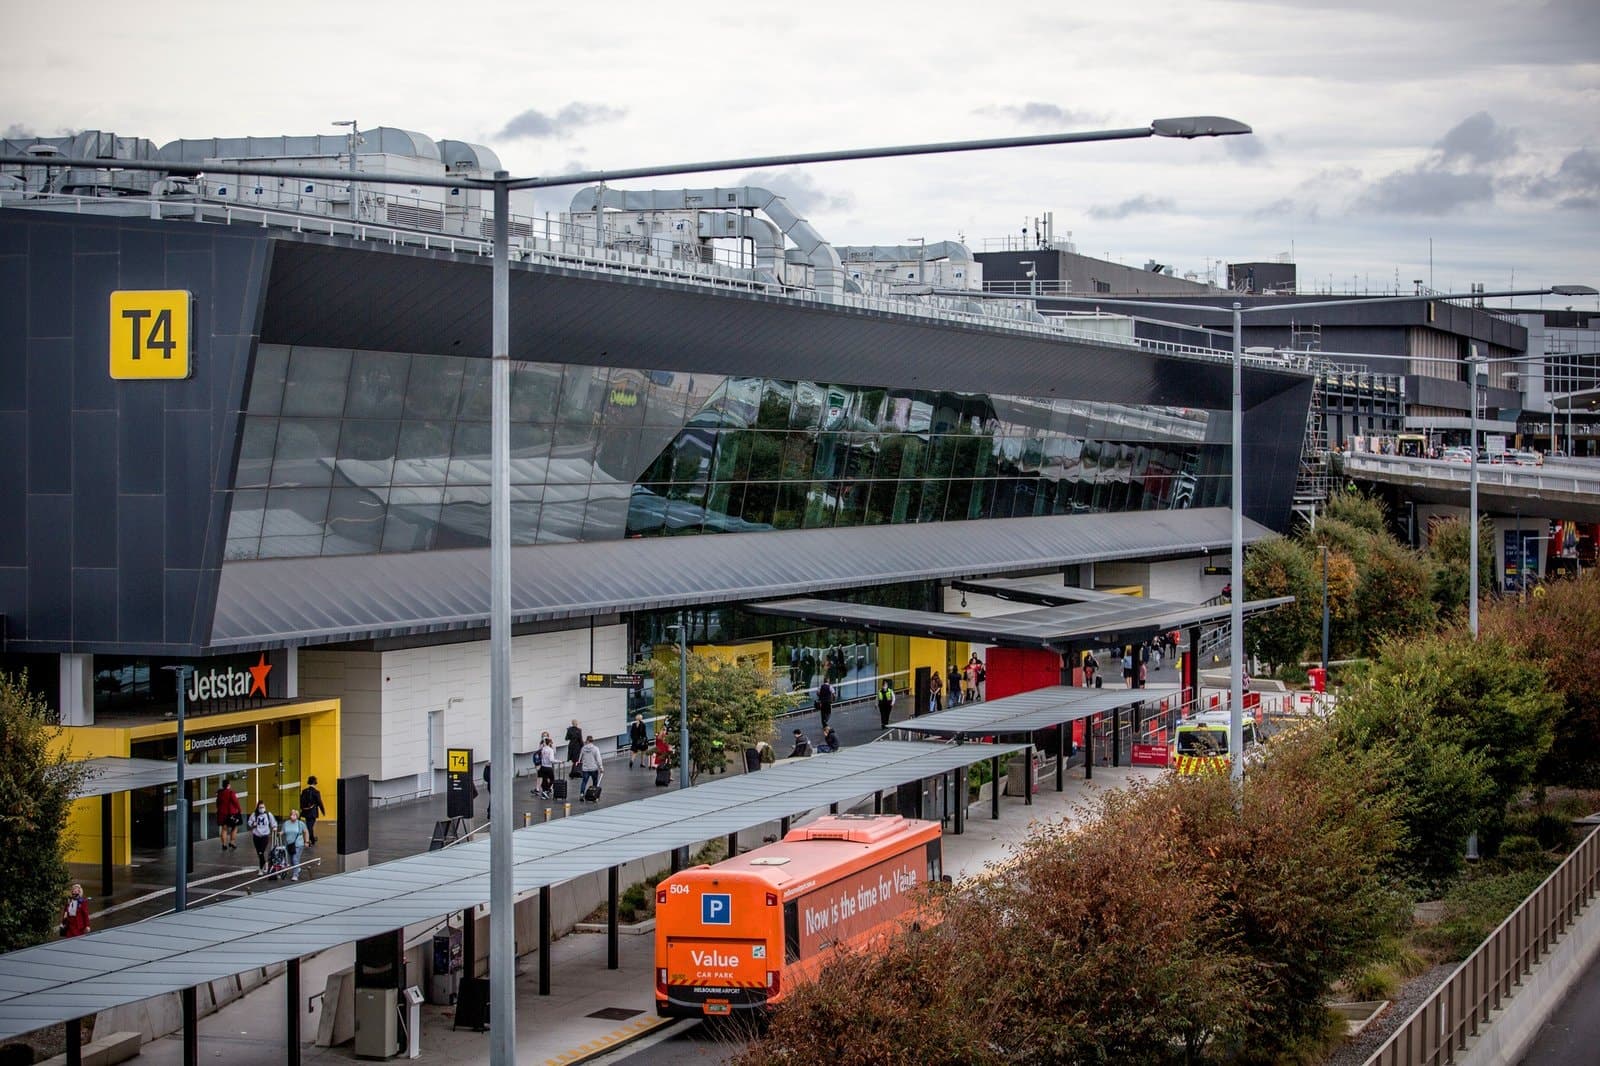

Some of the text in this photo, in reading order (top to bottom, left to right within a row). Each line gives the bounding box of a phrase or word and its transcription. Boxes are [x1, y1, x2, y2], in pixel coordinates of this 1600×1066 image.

[122, 309, 176, 360] T4
[188, 666, 252, 702] Jetstar
[191, 733, 248, 750] Domestic departures
[450, 755, 466, 767] T4
[670, 884, 690, 894] 504
[710, 899, 723, 919] P
[805, 864, 917, 937] Now is the time for Value
[691, 949, 740, 967] Value
[714, 971, 734, 979] PARK
